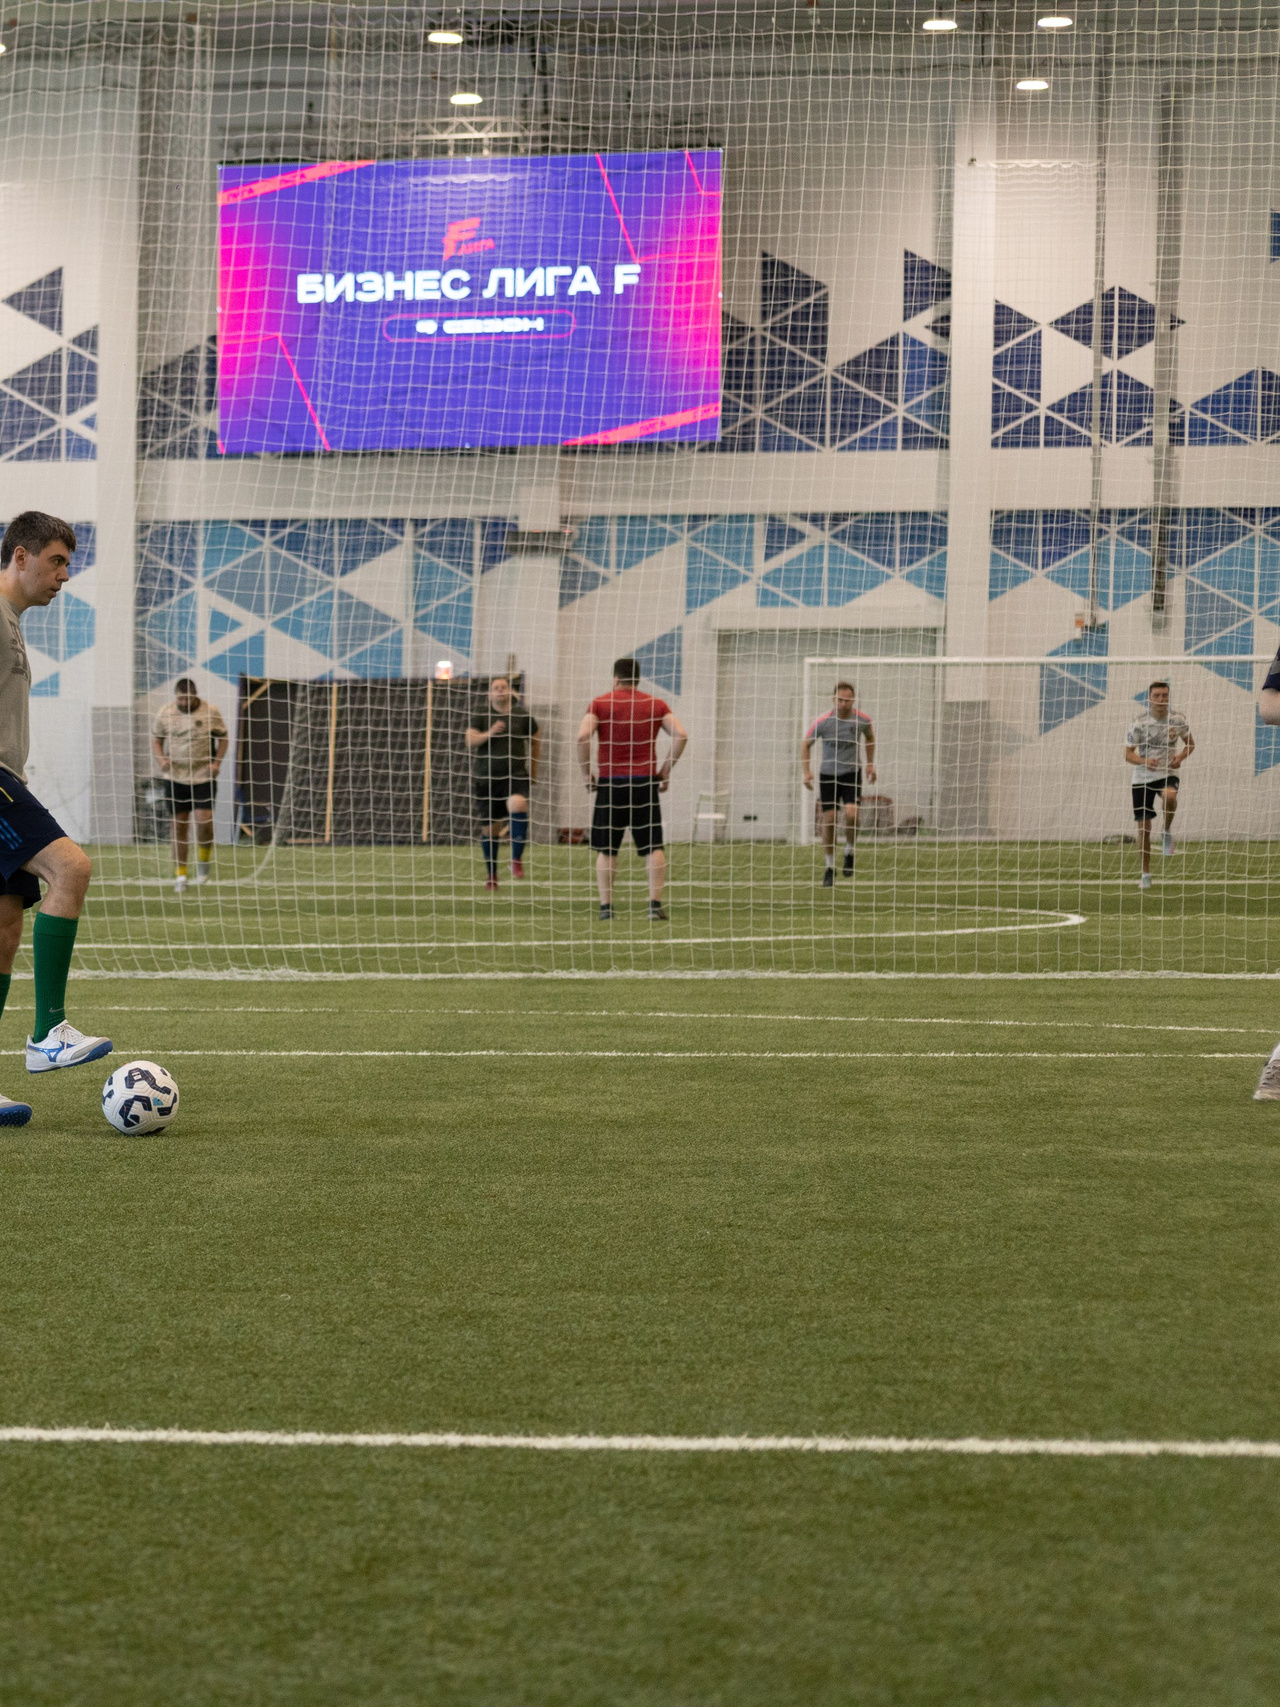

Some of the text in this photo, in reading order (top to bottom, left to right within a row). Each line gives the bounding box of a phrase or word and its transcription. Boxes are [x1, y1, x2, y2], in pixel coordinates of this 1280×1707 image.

[297, 264, 641, 304] БИЗНЕС ЛИГА F
